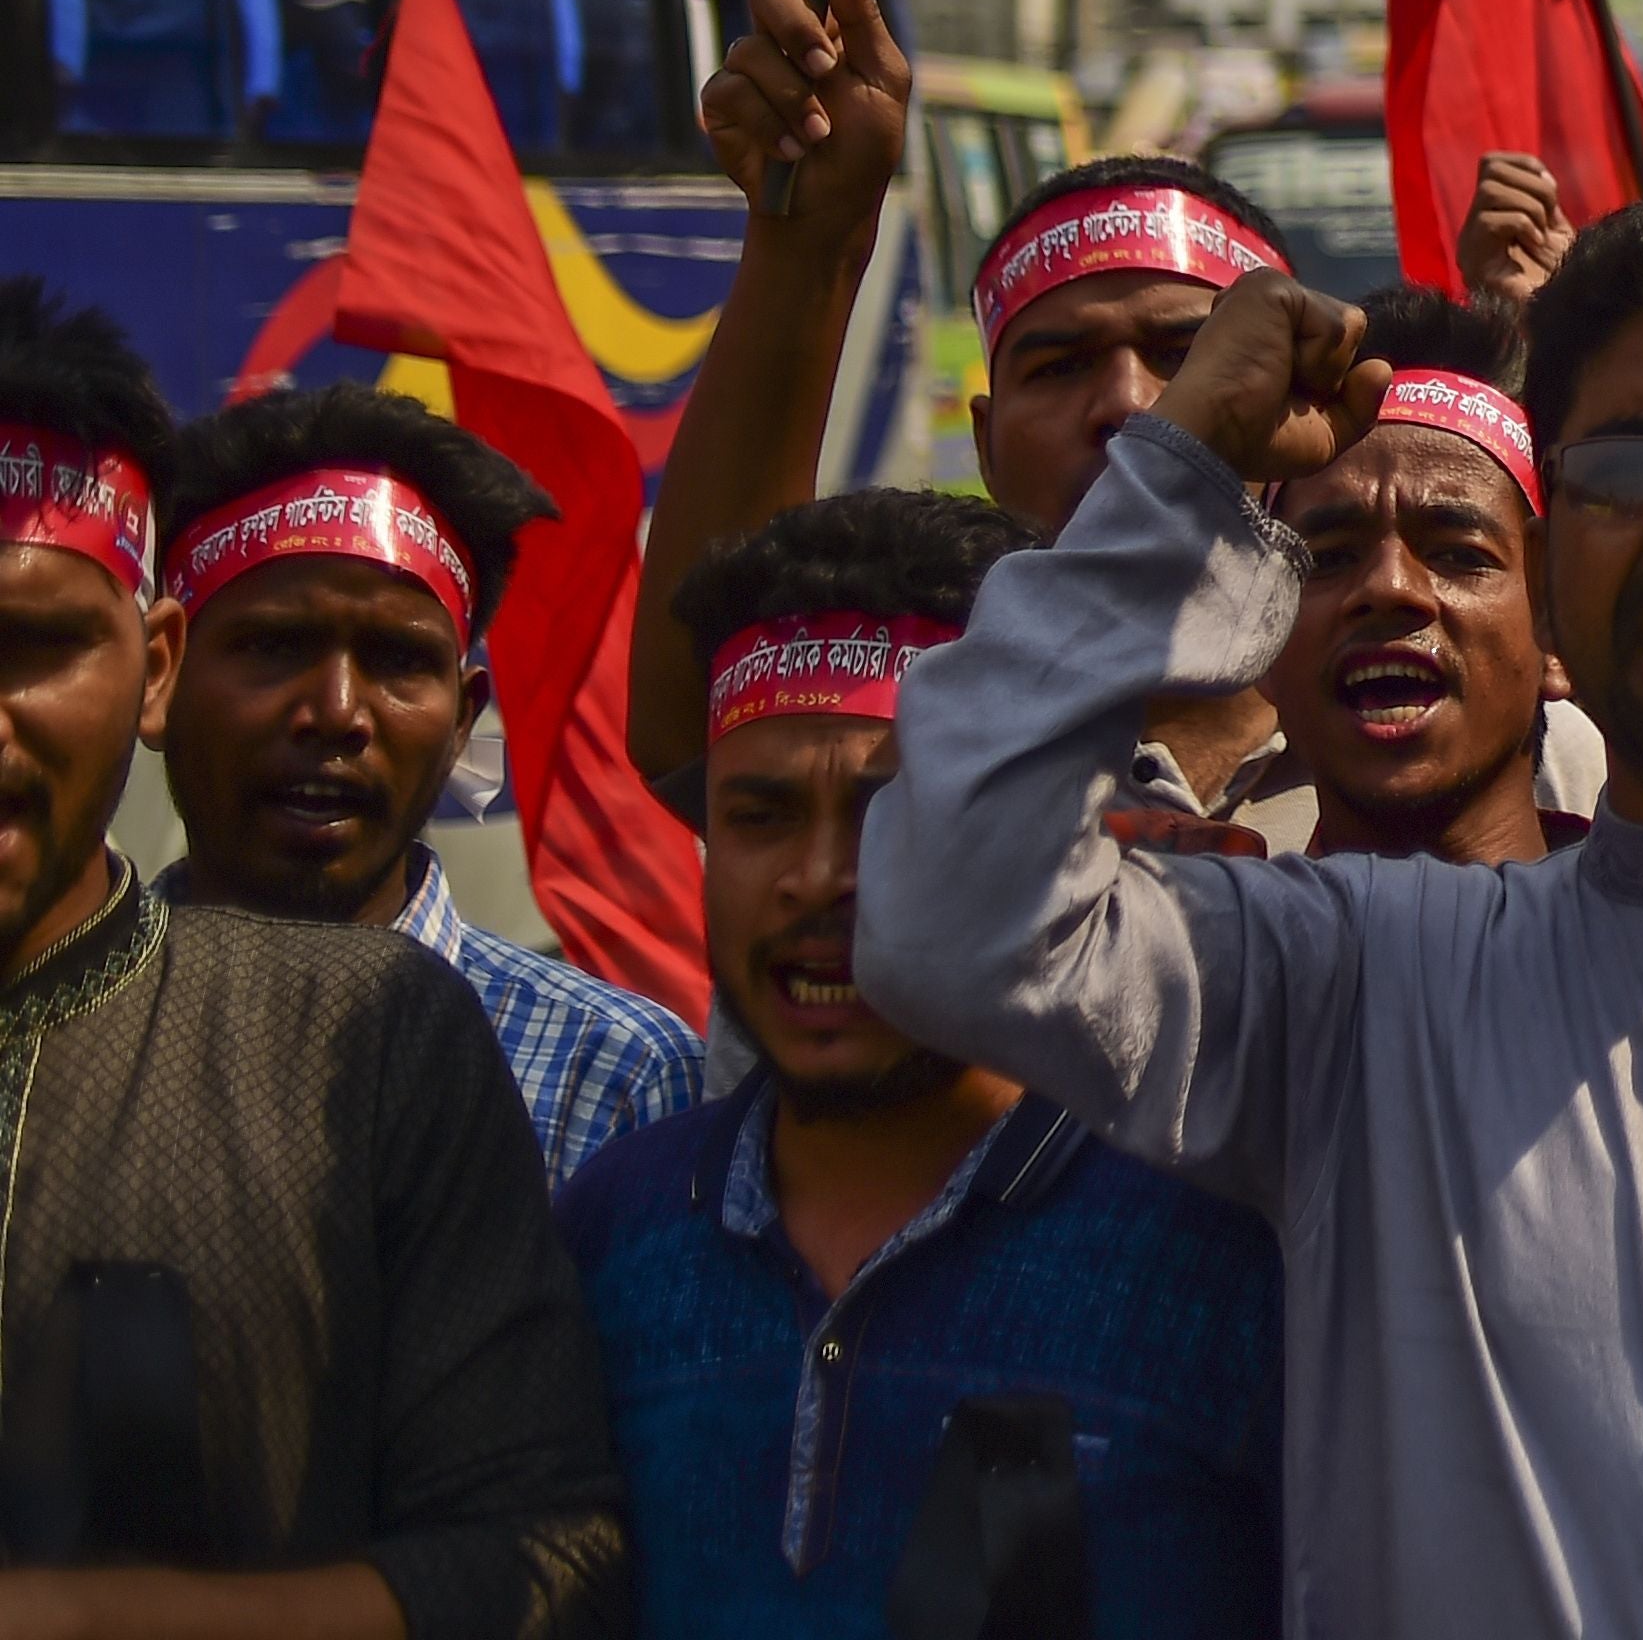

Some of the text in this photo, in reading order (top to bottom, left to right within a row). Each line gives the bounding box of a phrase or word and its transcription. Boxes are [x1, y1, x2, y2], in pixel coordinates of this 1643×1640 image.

[1083, 200, 1142, 243] গার্মেন্টস
[1395, 378, 1461, 411] গার্মেন্টস
[1459, 391, 1502, 426] শ্রমিক
[285, 484, 349, 529] গার্মেন্টস
[395, 505, 438, 557] কর্মচারী
[777, 625, 825, 681] শ্রমিক
[827, 622, 892, 682] কর্মচারী
